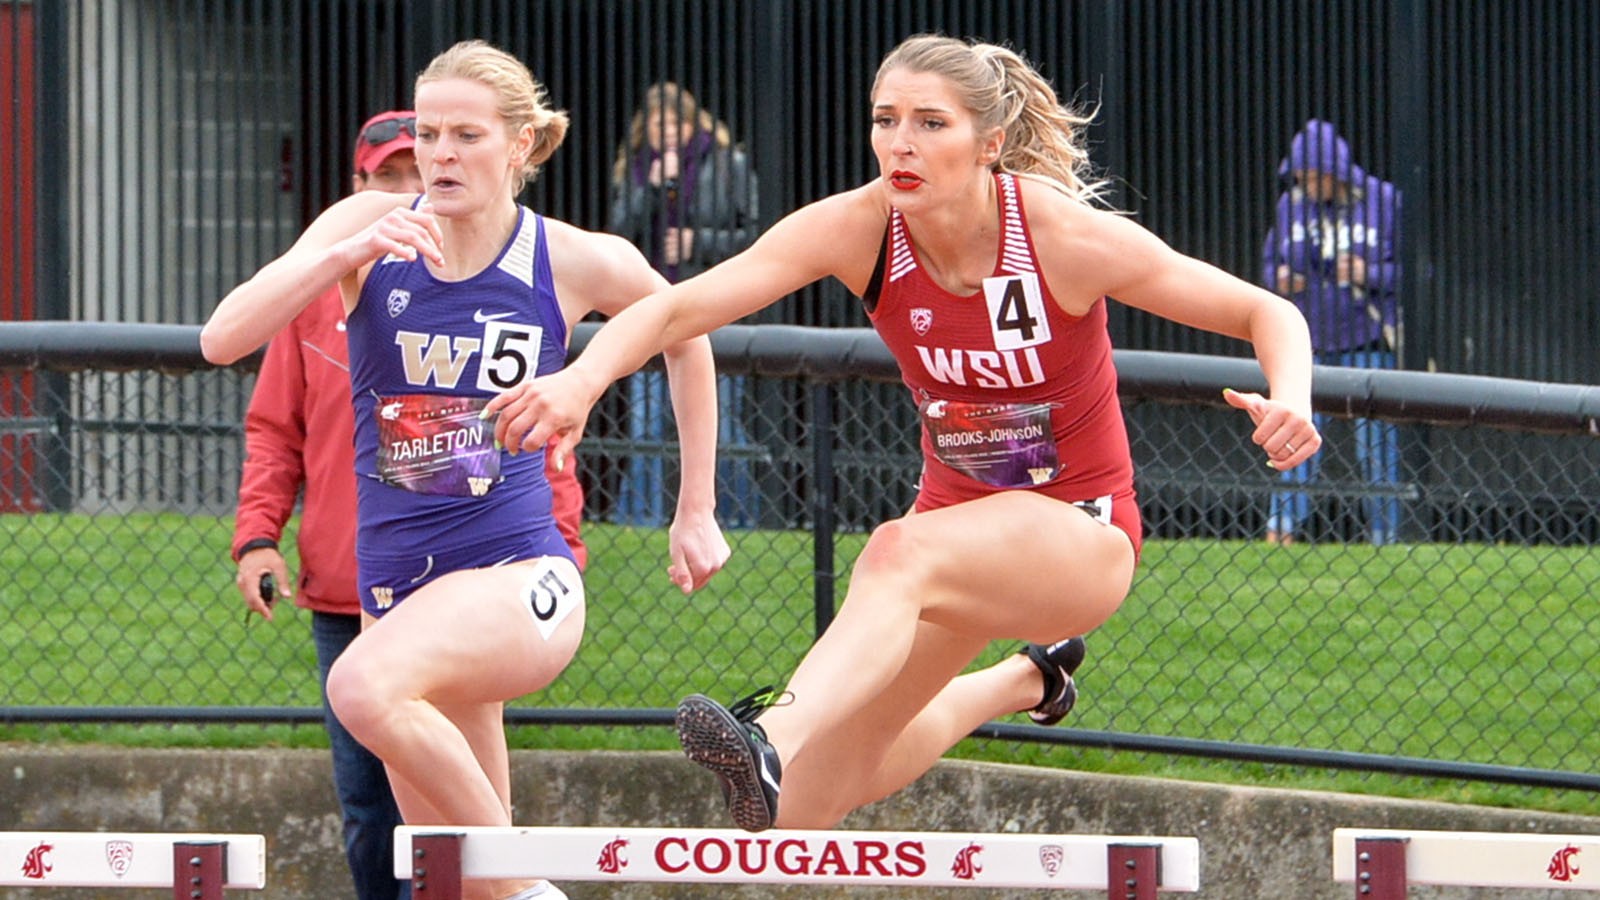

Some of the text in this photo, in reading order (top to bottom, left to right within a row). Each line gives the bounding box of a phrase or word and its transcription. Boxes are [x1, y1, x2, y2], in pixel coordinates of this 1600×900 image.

[996, 279, 1038, 341] 4
[395, 330, 481, 389] W
[487, 329, 530, 389] 5
[915, 345, 1047, 389] WSU
[391, 425, 484, 461] TARLETON
[937, 424, 1043, 448] BROOKS-JOHNSON
[467, 476, 494, 497] W
[530, 569, 570, 621] 5
[653, 836, 928, 878] COUGARS
